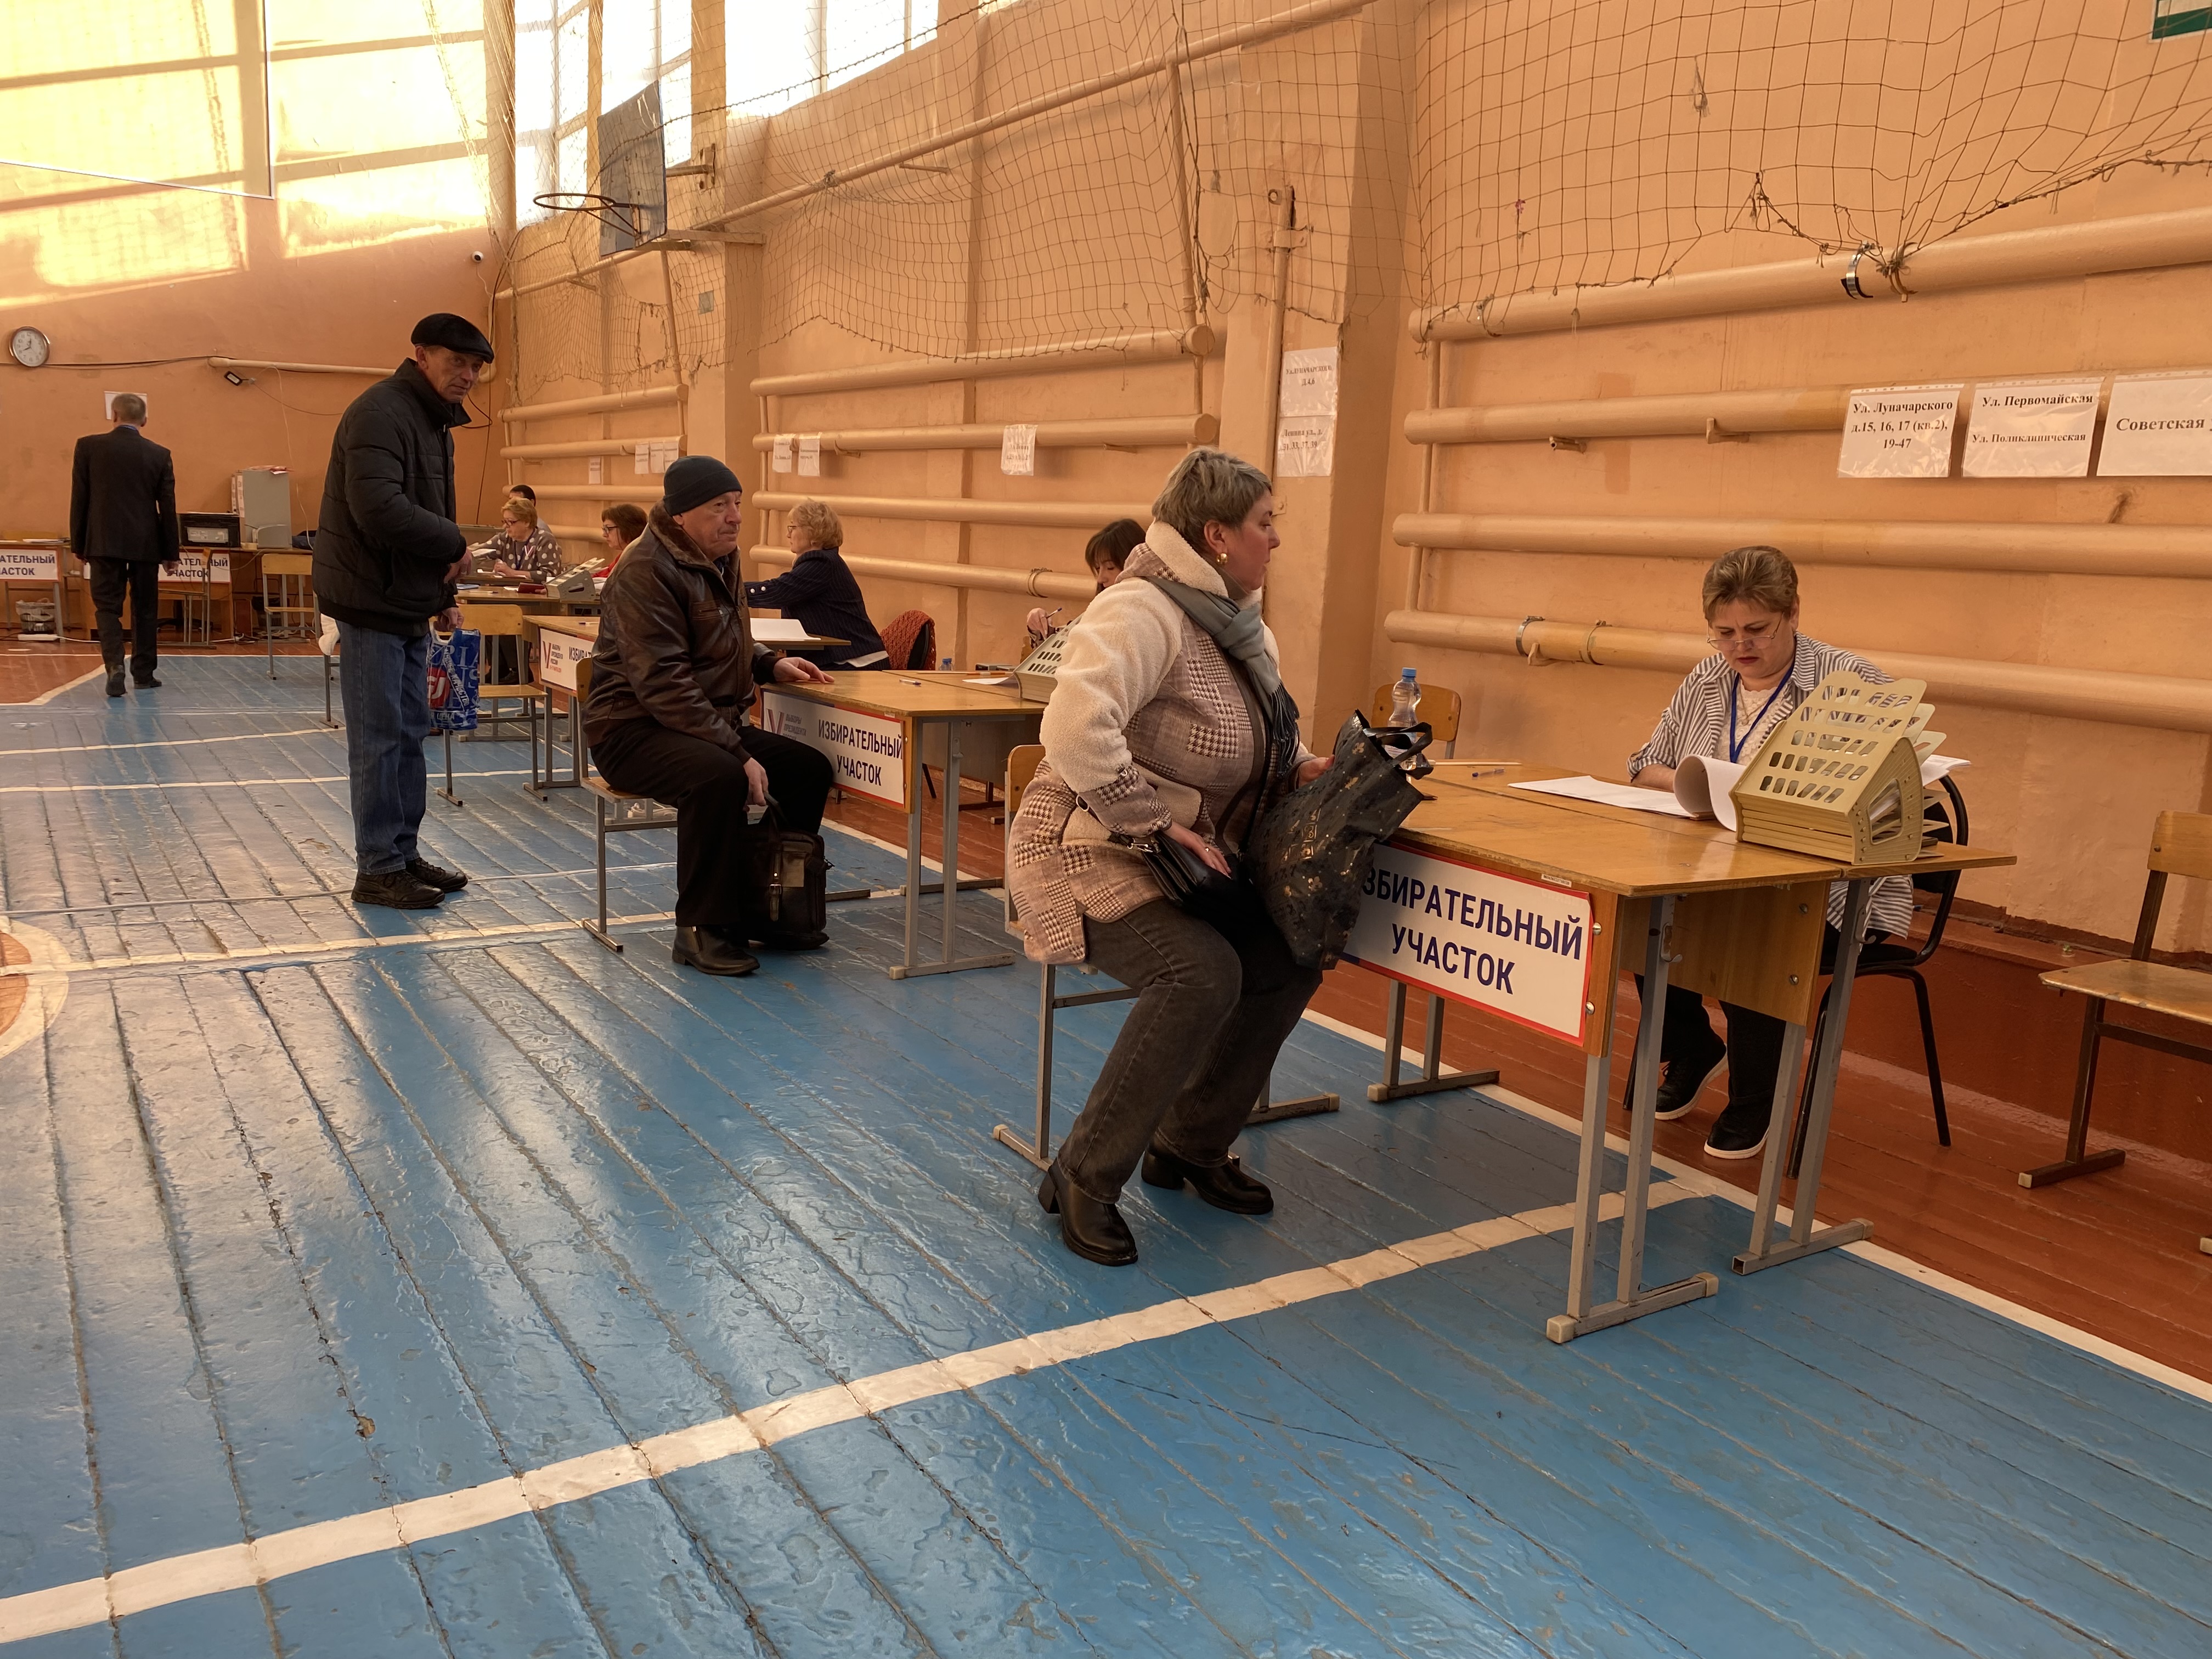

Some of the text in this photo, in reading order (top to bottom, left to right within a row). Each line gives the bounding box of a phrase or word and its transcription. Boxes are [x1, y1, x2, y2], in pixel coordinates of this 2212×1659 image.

[1982, 394, 2093, 408] Ул. Первомайская
[1853, 402, 1953, 415] Ул. Луначарского
[1851, 419, 1948, 433] д.15, 16, 17 (кв.2),
[2116, 418, 2205, 431] Советская
[1883, 438, 1911, 449] 19-47
[1972, 434, 2086, 443] Ул. Поликлиническая
[0, 554, 55, 563] АТЕЛЬНЫЙ
[179, 558, 228, 567] АТЕЛНЫЙ
[0, 567, 35, 575] АСТОК
[819, 719, 902, 760] ИЗБИРАТЕЛЬНЫЙ
[837, 754, 882, 786] УЧАСТОК
[1362, 866, 1583, 960] ЗБИРАТЕЛЬНЫЙ
[1392, 923, 1515, 995] УЧАСТОК
